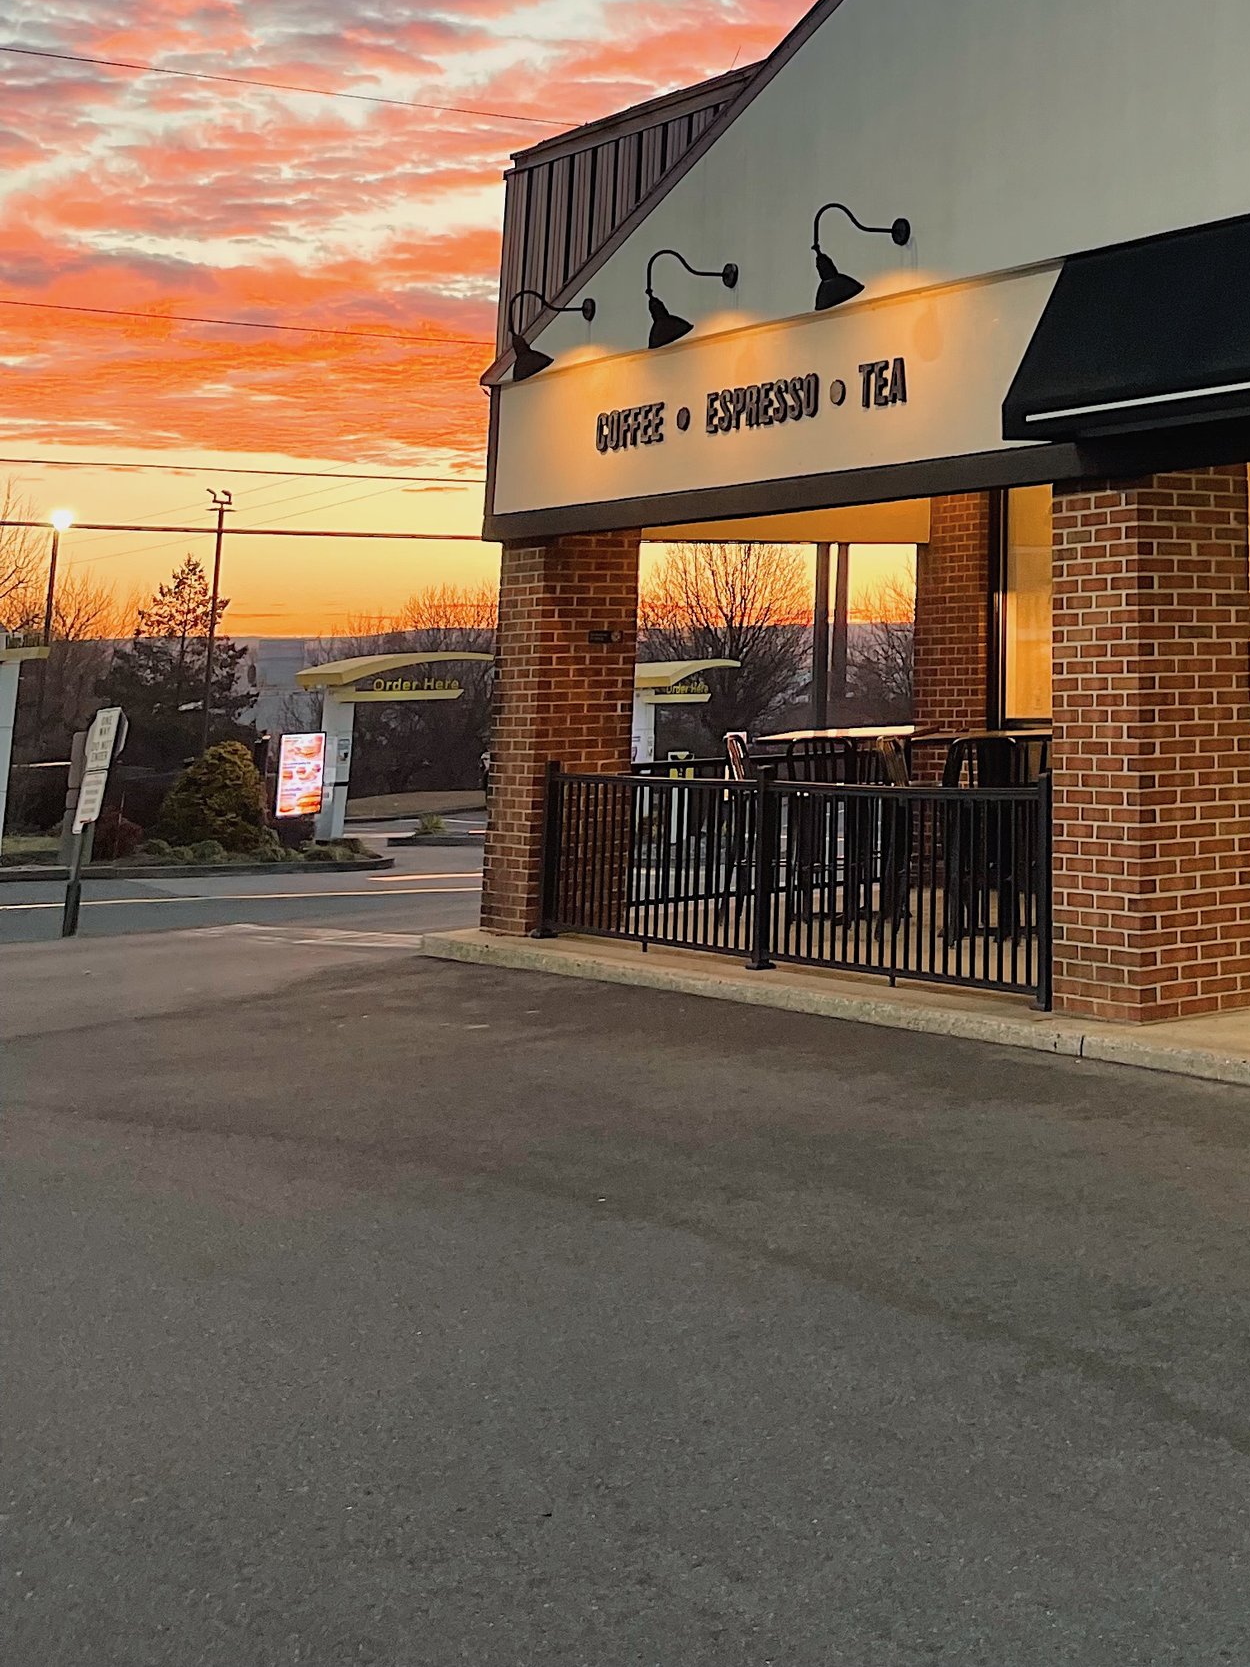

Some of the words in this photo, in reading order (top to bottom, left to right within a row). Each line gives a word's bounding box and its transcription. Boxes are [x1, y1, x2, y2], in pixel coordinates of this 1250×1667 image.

[595, 401, 666, 453] COFFEE
[705, 372, 819, 433] ESPRESSO
[858, 357, 908, 408] TEA
[373, 678, 418, 692] Order
[423, 677, 460, 691] Here
